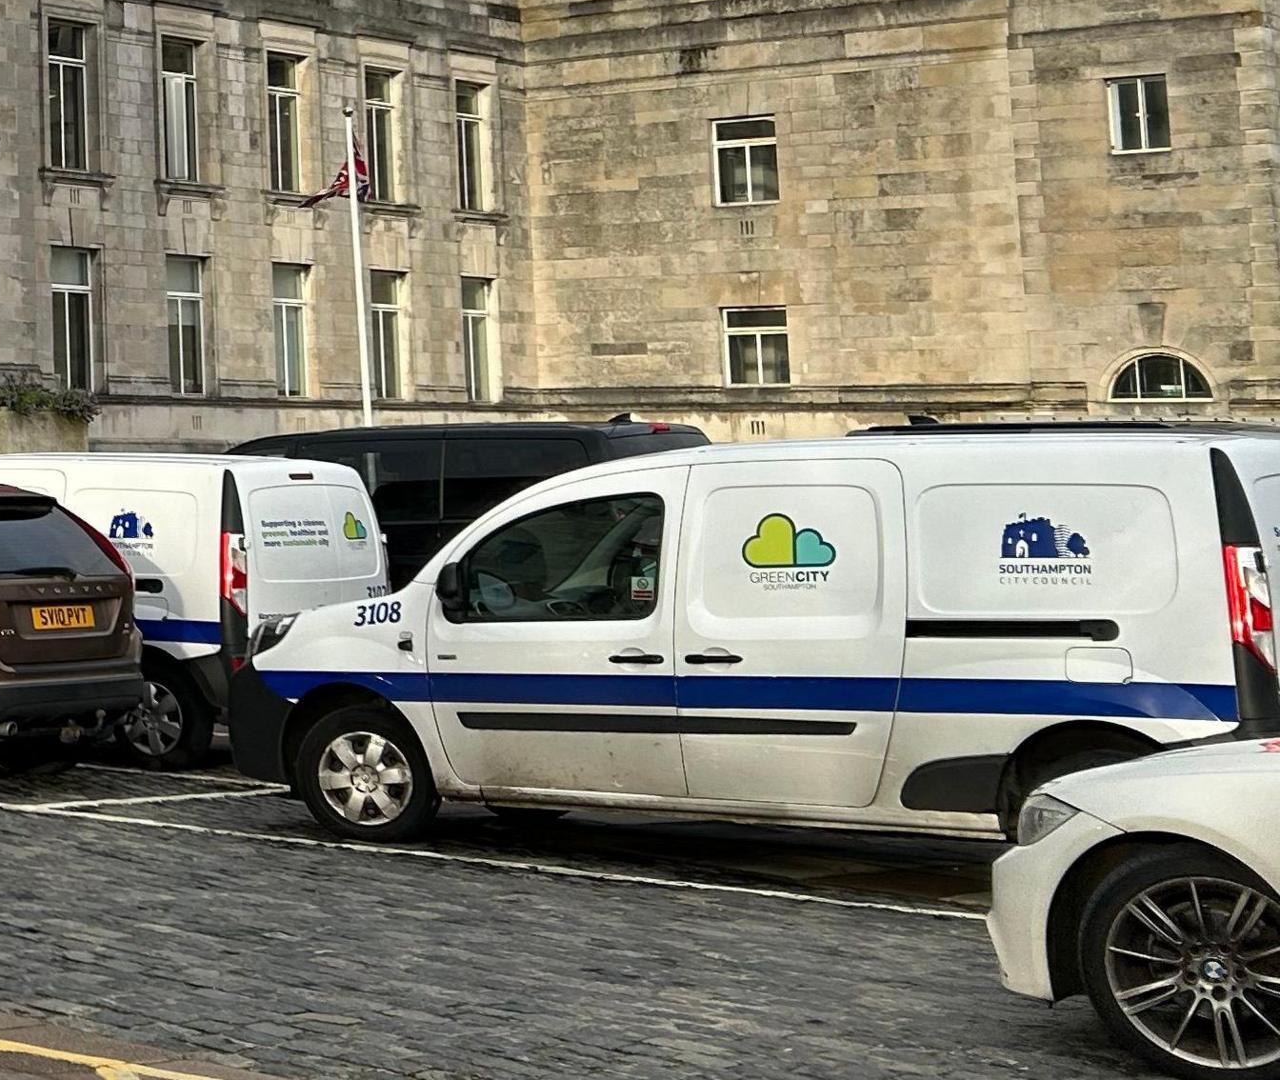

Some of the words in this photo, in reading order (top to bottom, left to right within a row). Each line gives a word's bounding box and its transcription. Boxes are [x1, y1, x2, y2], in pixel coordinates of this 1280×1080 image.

[261, 520, 297, 528] Supporting
[283, 539, 317, 547] sustainable
[999, 564, 1092, 575] SOUTHAMPTON
[749, 570, 830, 584] GREENCITY
[1000, 576, 1028, 585] CITY
[1033, 576, 1092, 585] COUNCIL
[763, 583, 817, 591] SOUTHAMPTON
[40, 607, 66, 626] SV10
[67, 607, 87, 625] PVT
[354, 601, 402, 627] 3108
